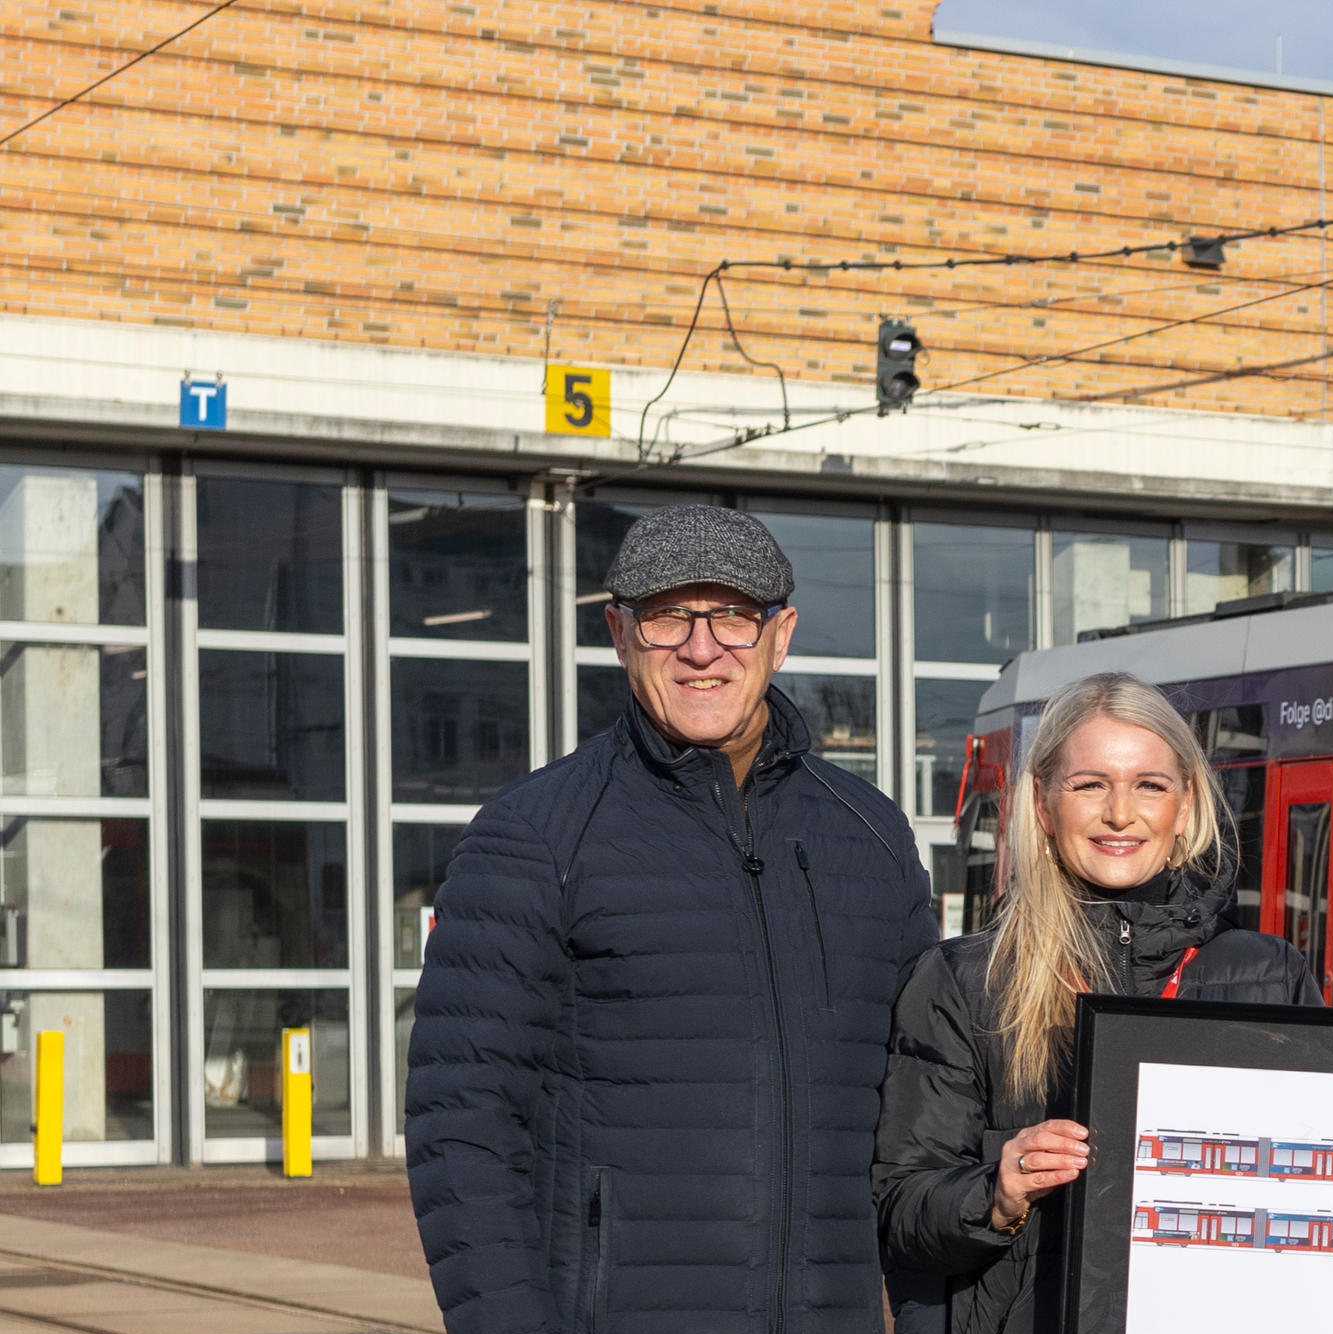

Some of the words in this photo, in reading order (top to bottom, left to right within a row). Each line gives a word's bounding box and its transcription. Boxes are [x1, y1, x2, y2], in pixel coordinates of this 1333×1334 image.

[189, 386, 217, 421] T
[564, 373, 594, 427] 5
[1280, 701, 1311, 729] Folge
